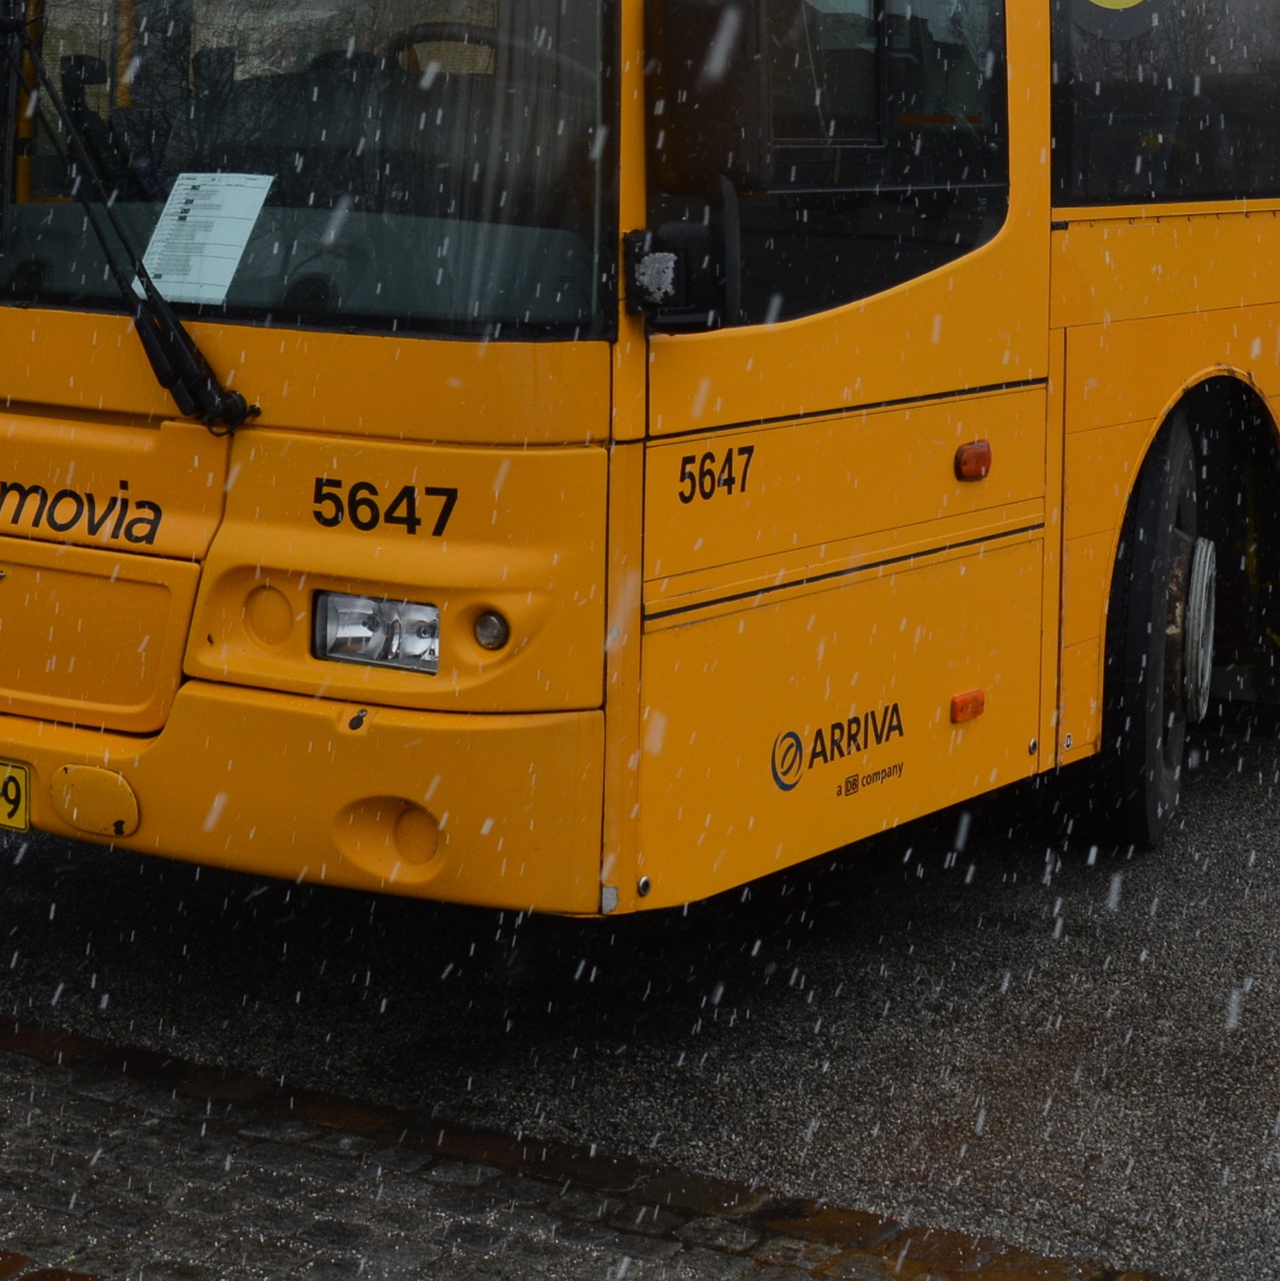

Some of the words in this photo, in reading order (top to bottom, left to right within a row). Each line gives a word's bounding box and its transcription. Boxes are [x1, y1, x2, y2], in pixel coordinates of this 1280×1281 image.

[678, 445, 754, 504] 5647
[312, 478, 458, 537] 5647
[808, 702, 904, 770] ARRIVA
[836, 785, 842, 797] a
[846, 776, 858, 794] DB
[861, 762, 904, 787] company
